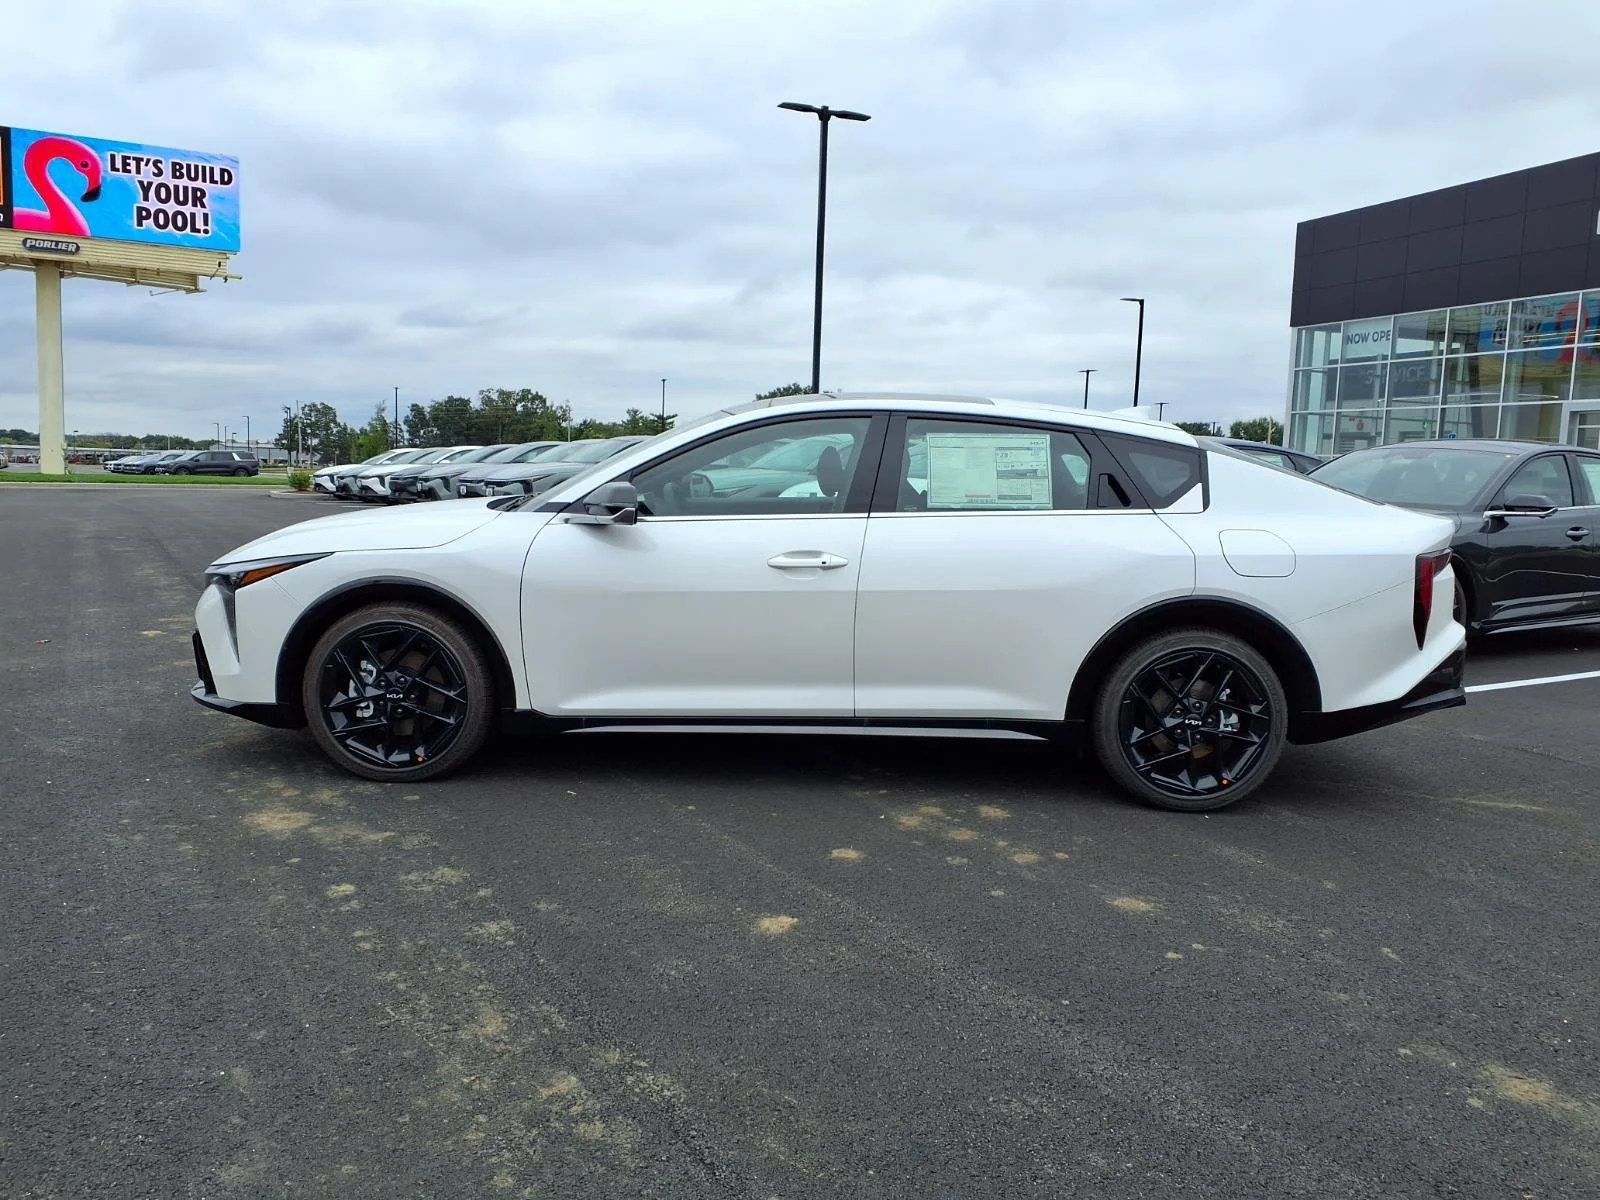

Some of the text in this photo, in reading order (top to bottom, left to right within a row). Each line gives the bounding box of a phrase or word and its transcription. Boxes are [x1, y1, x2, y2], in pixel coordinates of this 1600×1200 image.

[109, 153, 233, 186] LET'S BUILD
[137, 180, 207, 209] YOUR
[136, 205, 210, 235] POOL!
[26, 239, 77, 253] PORLIER
[1346, 332, 1370, 345] NOW
